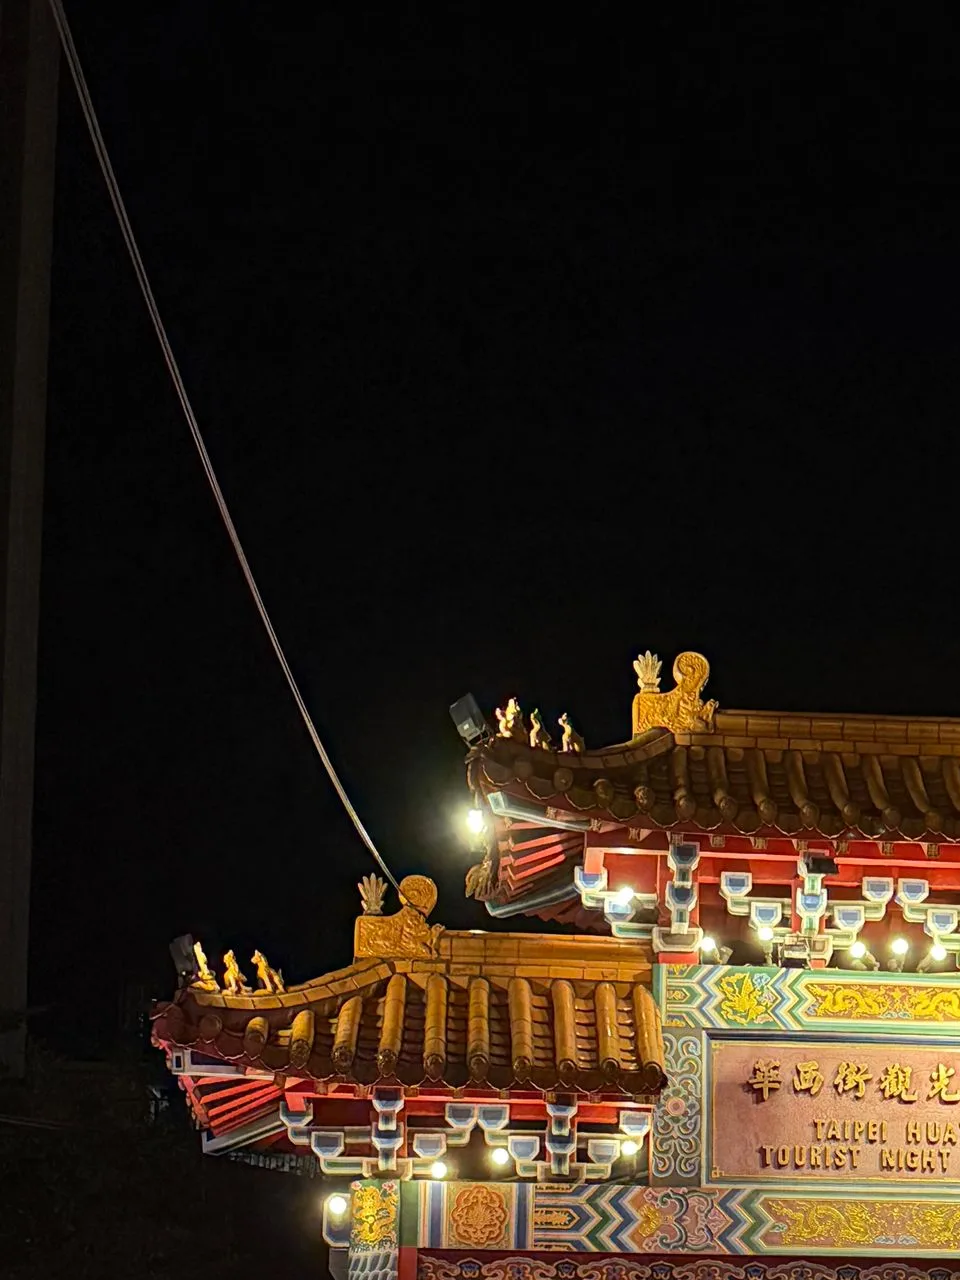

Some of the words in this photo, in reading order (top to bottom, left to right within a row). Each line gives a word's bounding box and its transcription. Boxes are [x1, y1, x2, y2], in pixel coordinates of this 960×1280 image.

[813, 1119, 887, 1143] TAIPEI
[762, 1145, 860, 1170] TOURIST
[881, 1148, 951, 1173] NIGHT
